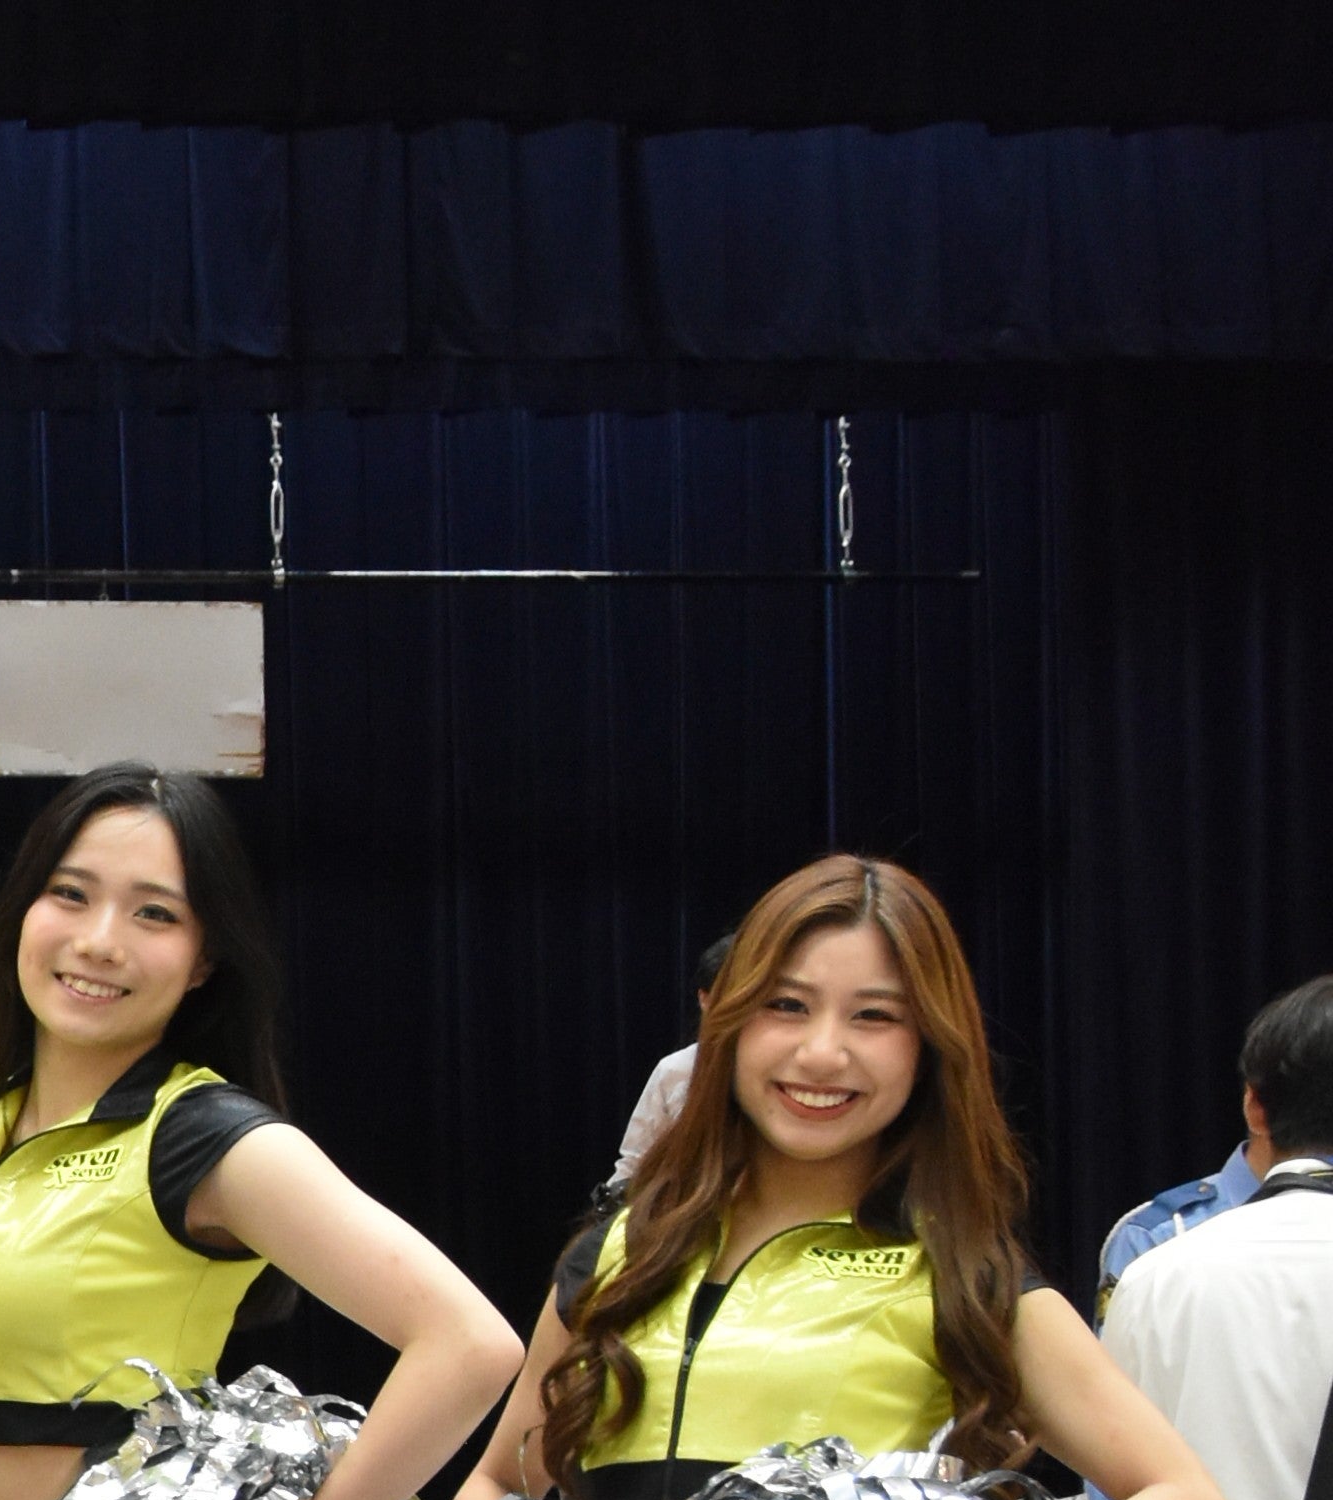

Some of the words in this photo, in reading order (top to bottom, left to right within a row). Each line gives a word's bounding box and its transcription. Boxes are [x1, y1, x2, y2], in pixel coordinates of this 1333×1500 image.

[48, 1148, 120, 1169] seven
[69, 1166, 113, 1178] seven
[808, 1246, 905, 1265] seven
[841, 1265, 900, 1276] seven
